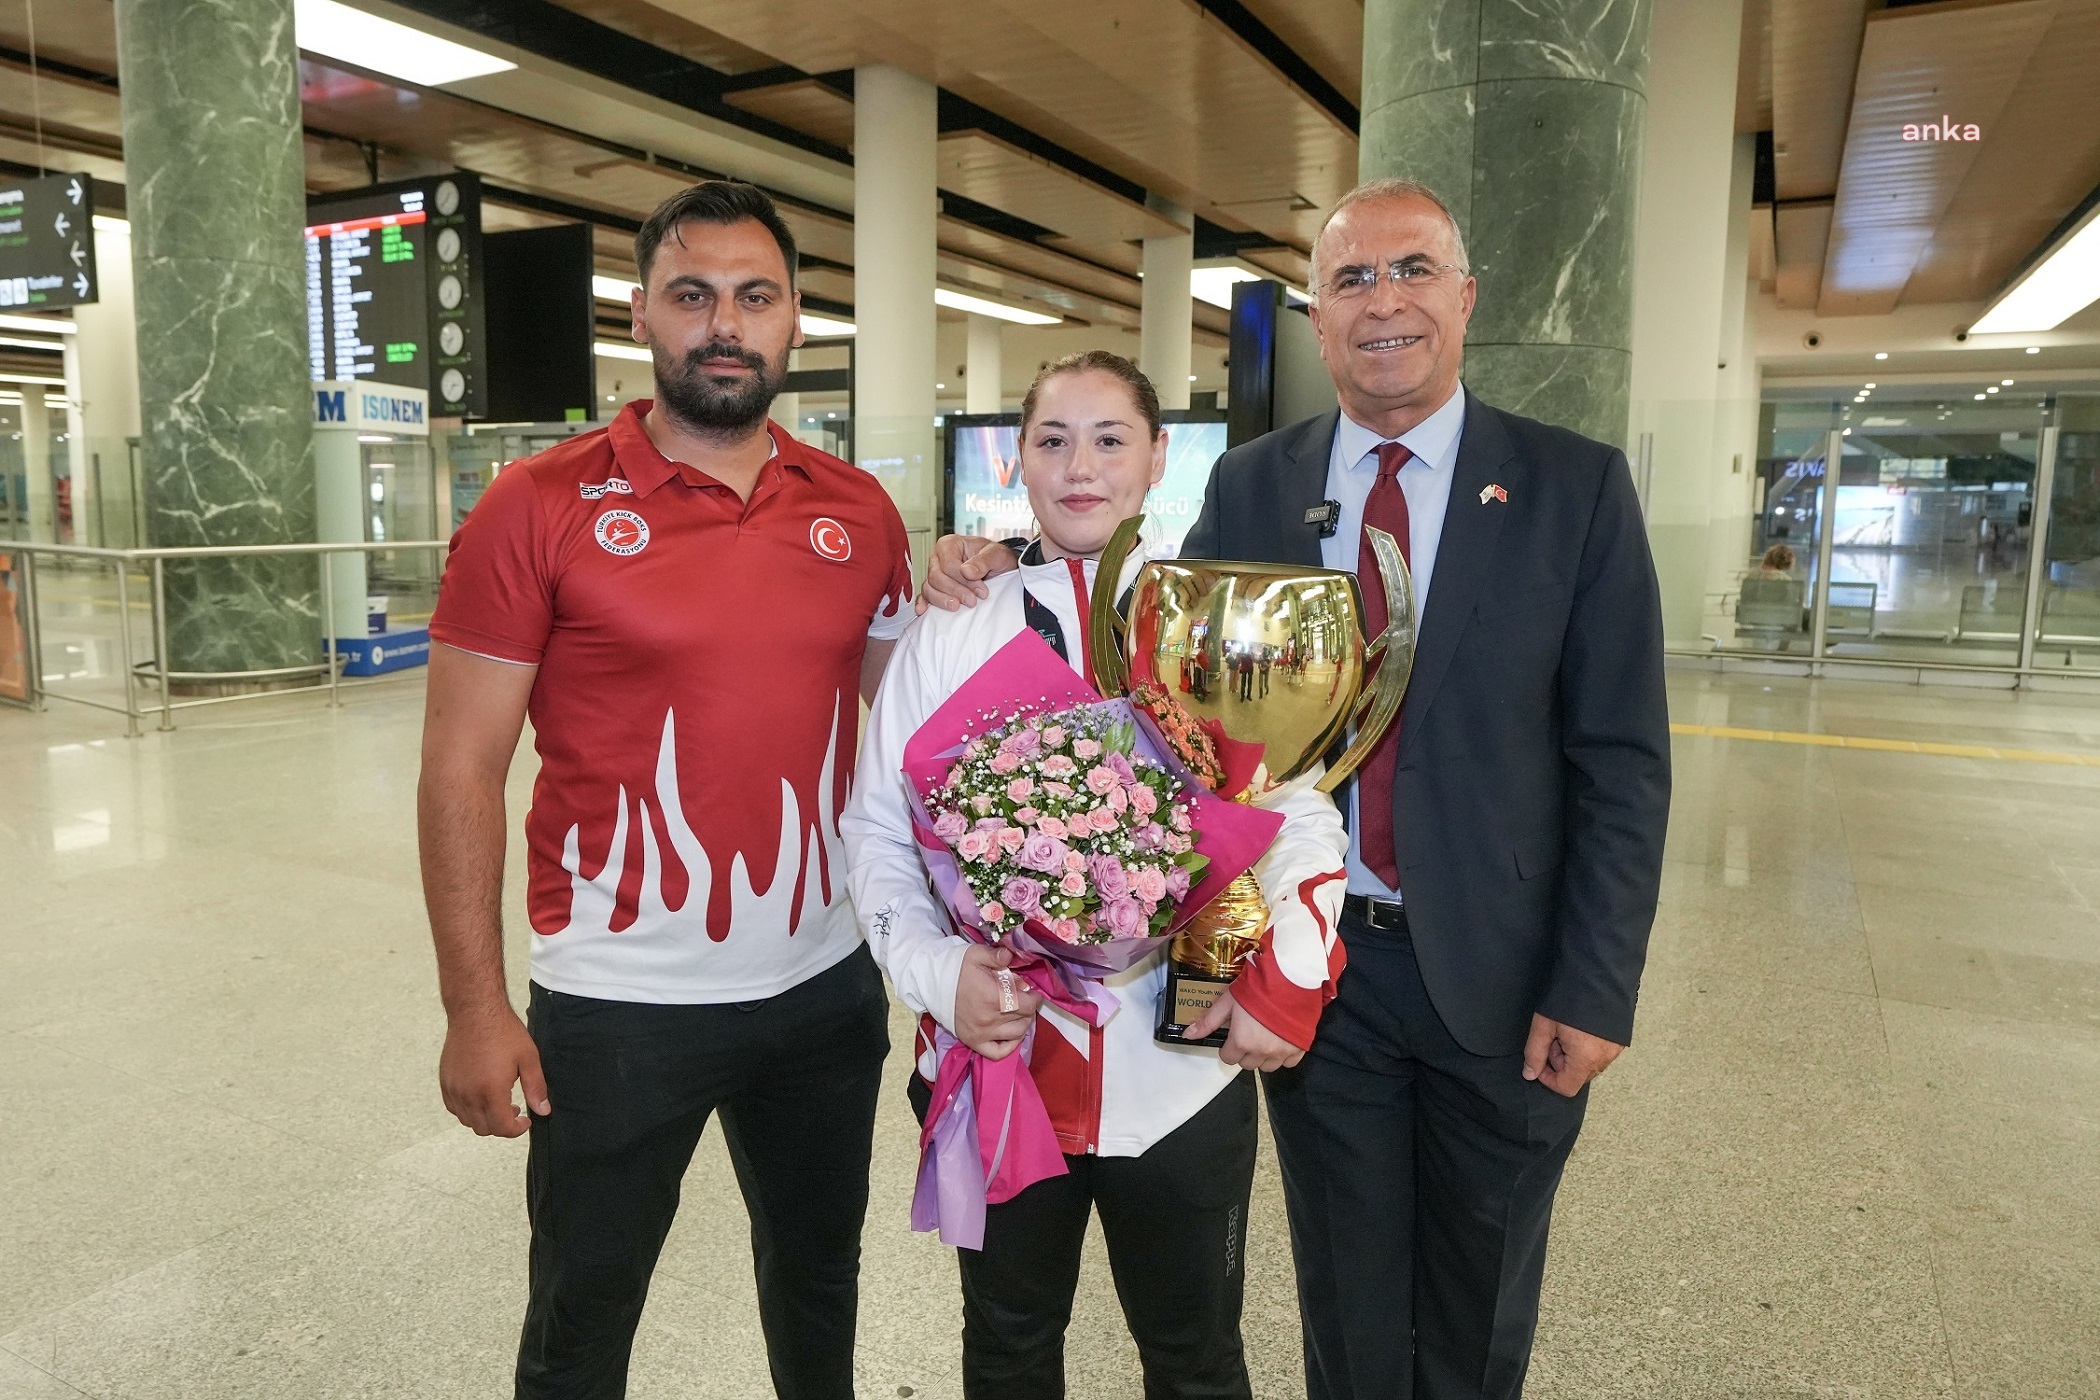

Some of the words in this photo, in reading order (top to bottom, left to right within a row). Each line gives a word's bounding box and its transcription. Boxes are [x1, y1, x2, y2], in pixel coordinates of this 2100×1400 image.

[312, 391, 346, 422] M
[362, 394, 423, 424] ISONEM
[965, 492, 1028, 513] Kesinti
[1152, 496, 1189, 516] ücü
[633, 516, 646, 532] BOKS
[601, 538, 646, 554] FEDERASYONU
[1177, 997, 1213, 1009] WORLD
